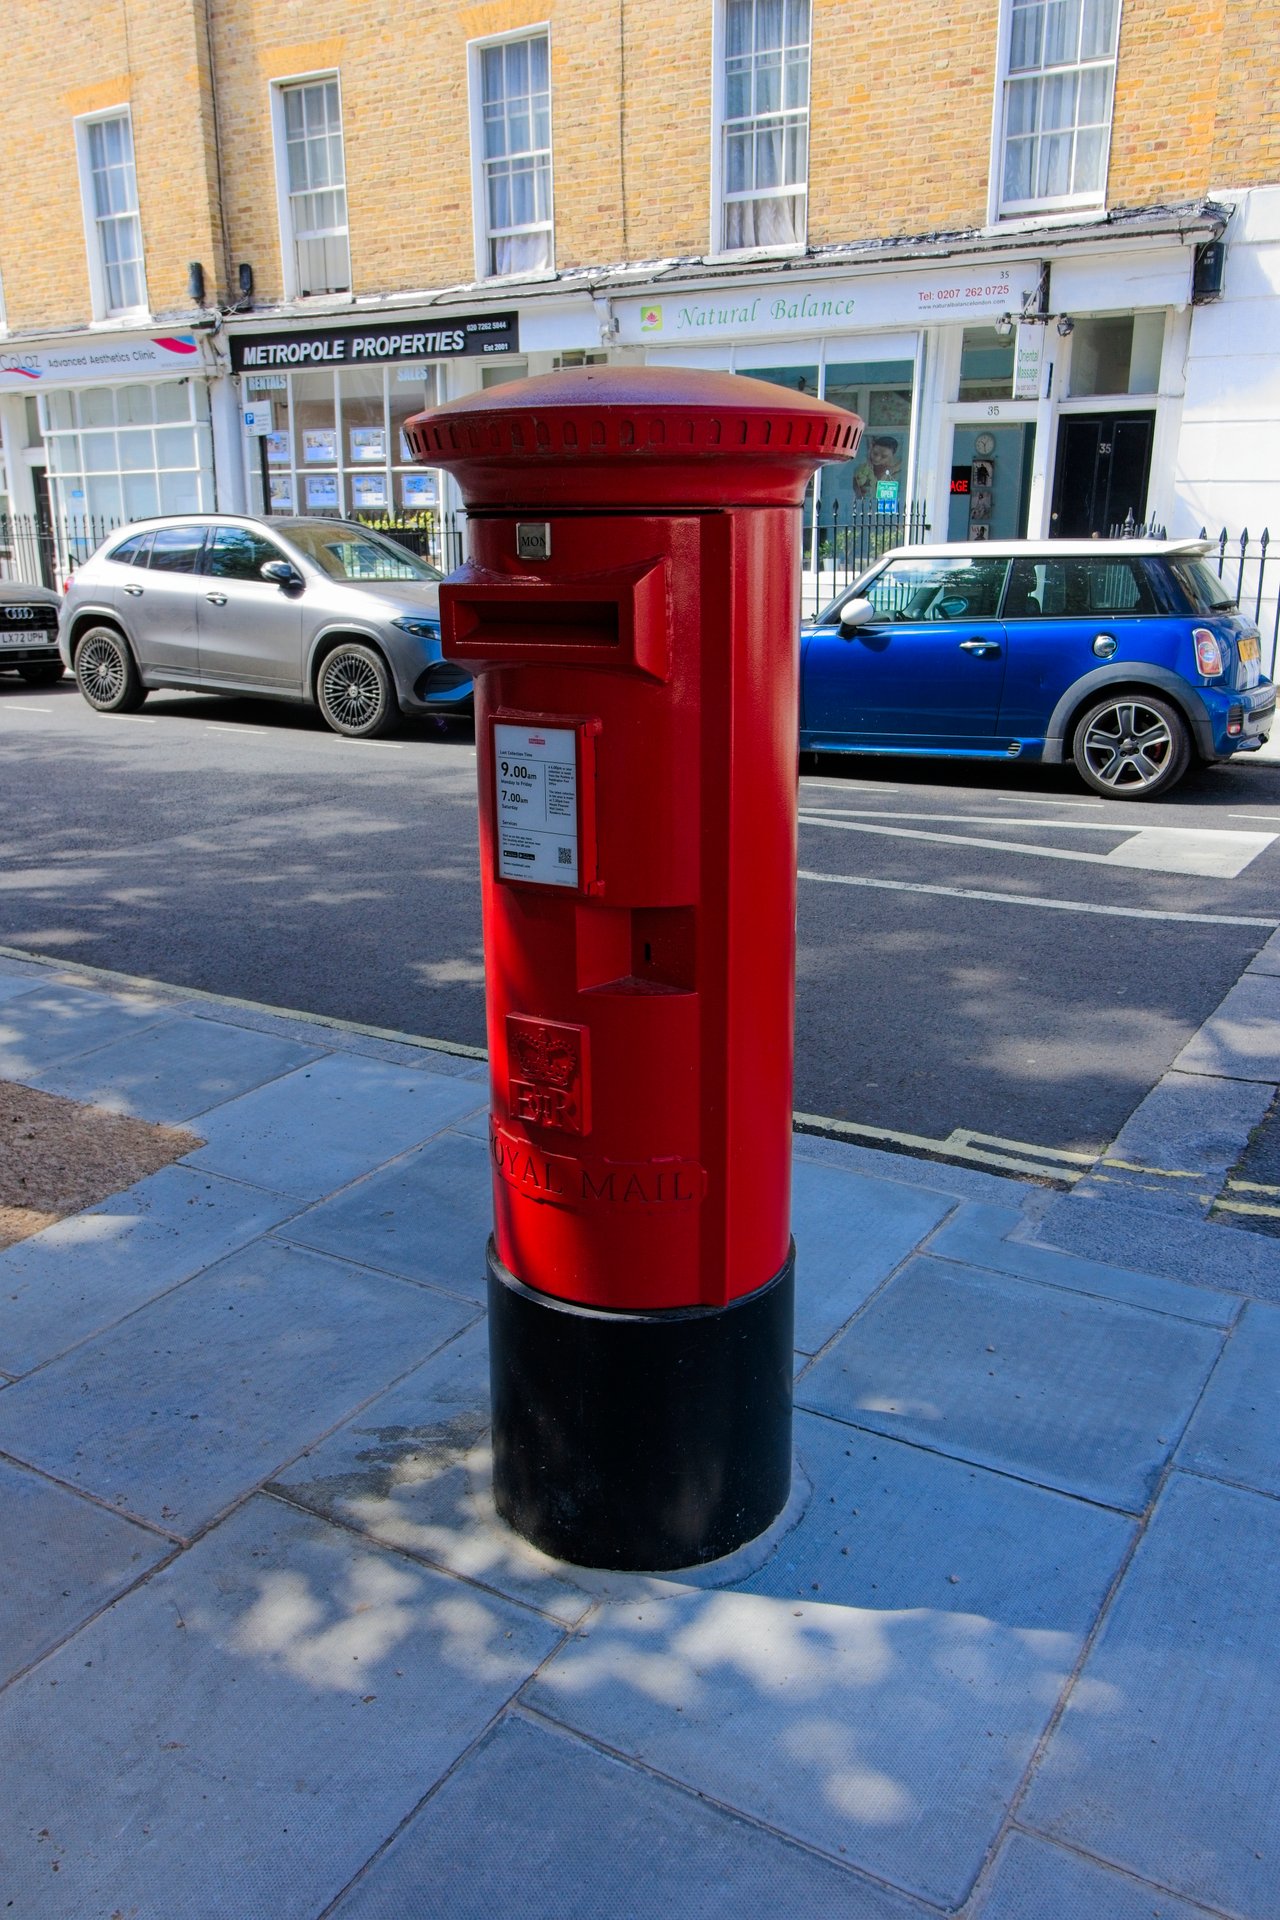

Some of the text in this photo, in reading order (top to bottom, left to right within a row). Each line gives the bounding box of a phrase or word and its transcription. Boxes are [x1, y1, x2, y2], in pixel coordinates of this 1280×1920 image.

[1000, 270, 1010, 279] 35
[918, 284, 1009, 301] Tel: 0207 262 0725
[677, 293, 855, 329] Natural Balance
[243, 330, 465, 365] METROPOLE PROPERTIES
[483, 344, 494, 352] Est
[48, 349, 157, 368] Advanced Aesthetics Clinic
[397, 365, 428, 381] SALES
[247, 375, 287, 391] RENTALS
[987, 405, 1000, 416] 35
[246, 413, 254, 424] P
[1099, 443, 1112, 454] 35
[521, 536, 546, 547] MON
[2, 632, 44, 643] LX72 UPH
[501, 761, 537, 780] 9.00am
[501, 790, 528, 804] 7.00am
[501, 803, 518, 811] Saturday
[580, 1170, 693, 1203] MAIL
